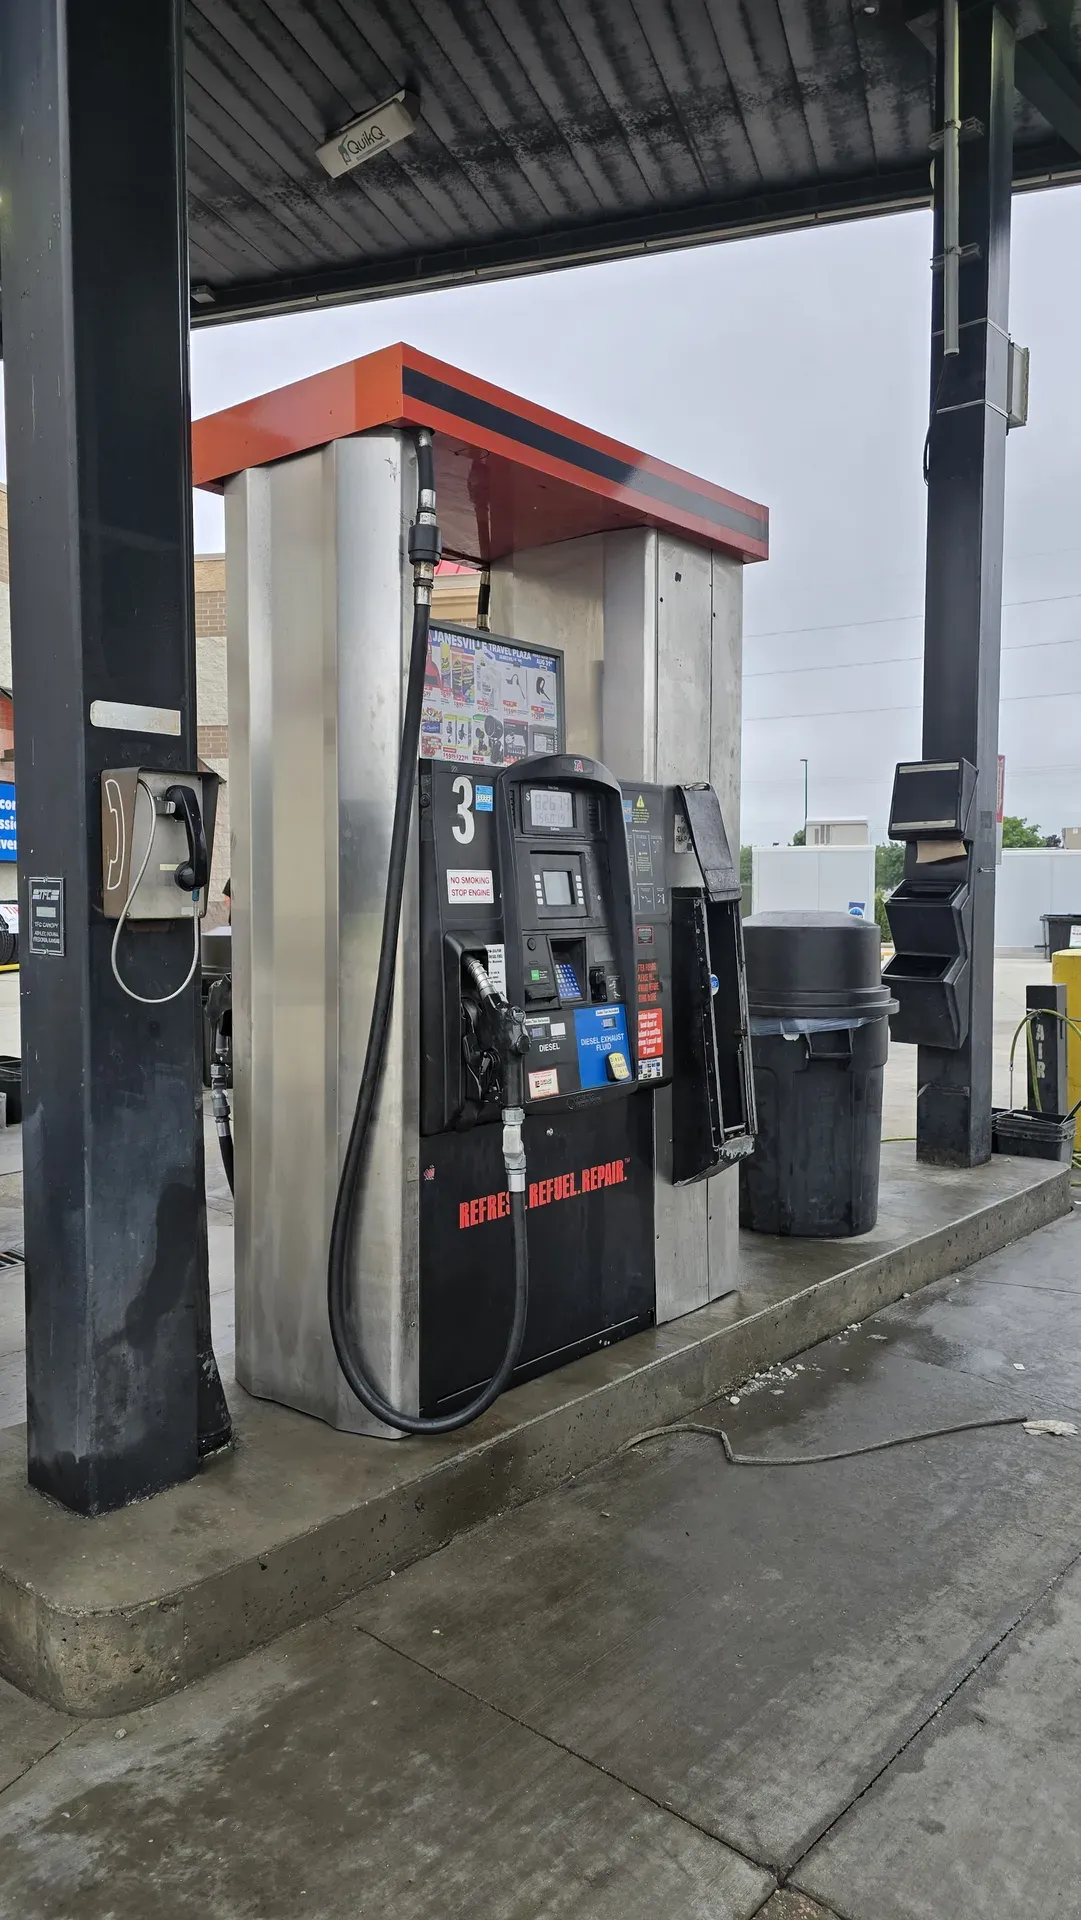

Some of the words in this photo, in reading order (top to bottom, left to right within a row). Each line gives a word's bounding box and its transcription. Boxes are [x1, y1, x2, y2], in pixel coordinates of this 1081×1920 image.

[347, 125, 386, 154] QuikQ
[432, 629, 487, 651] JANESVILLE
[489, 643, 512, 656] TRAVEL
[512, 648, 532, 660] PLAZA
[573, 759, 584, 773] TA
[525, 792, 531, 801] $
[452, 776, 475, 845] 3
[450, 876, 460, 884] NO
[461, 876, 490, 885] SMOKING
[451, 888, 467, 896] STOP
[468, 889, 490, 897] ENGINE
[581, 1037, 600, 1046] DIESEL
[600, 1033, 624, 1043] EXHAUST
[539, 1043, 560, 1052] DIESEL
[596, 1043, 612, 1051] FLUID
[1035, 1024, 1046, 1078] AIR
[459, 1191, 528, 1229] REFRES.
[529, 1172, 581, 1209] REFUEL.
[581, 1159, 628, 1193] REPAIR.
